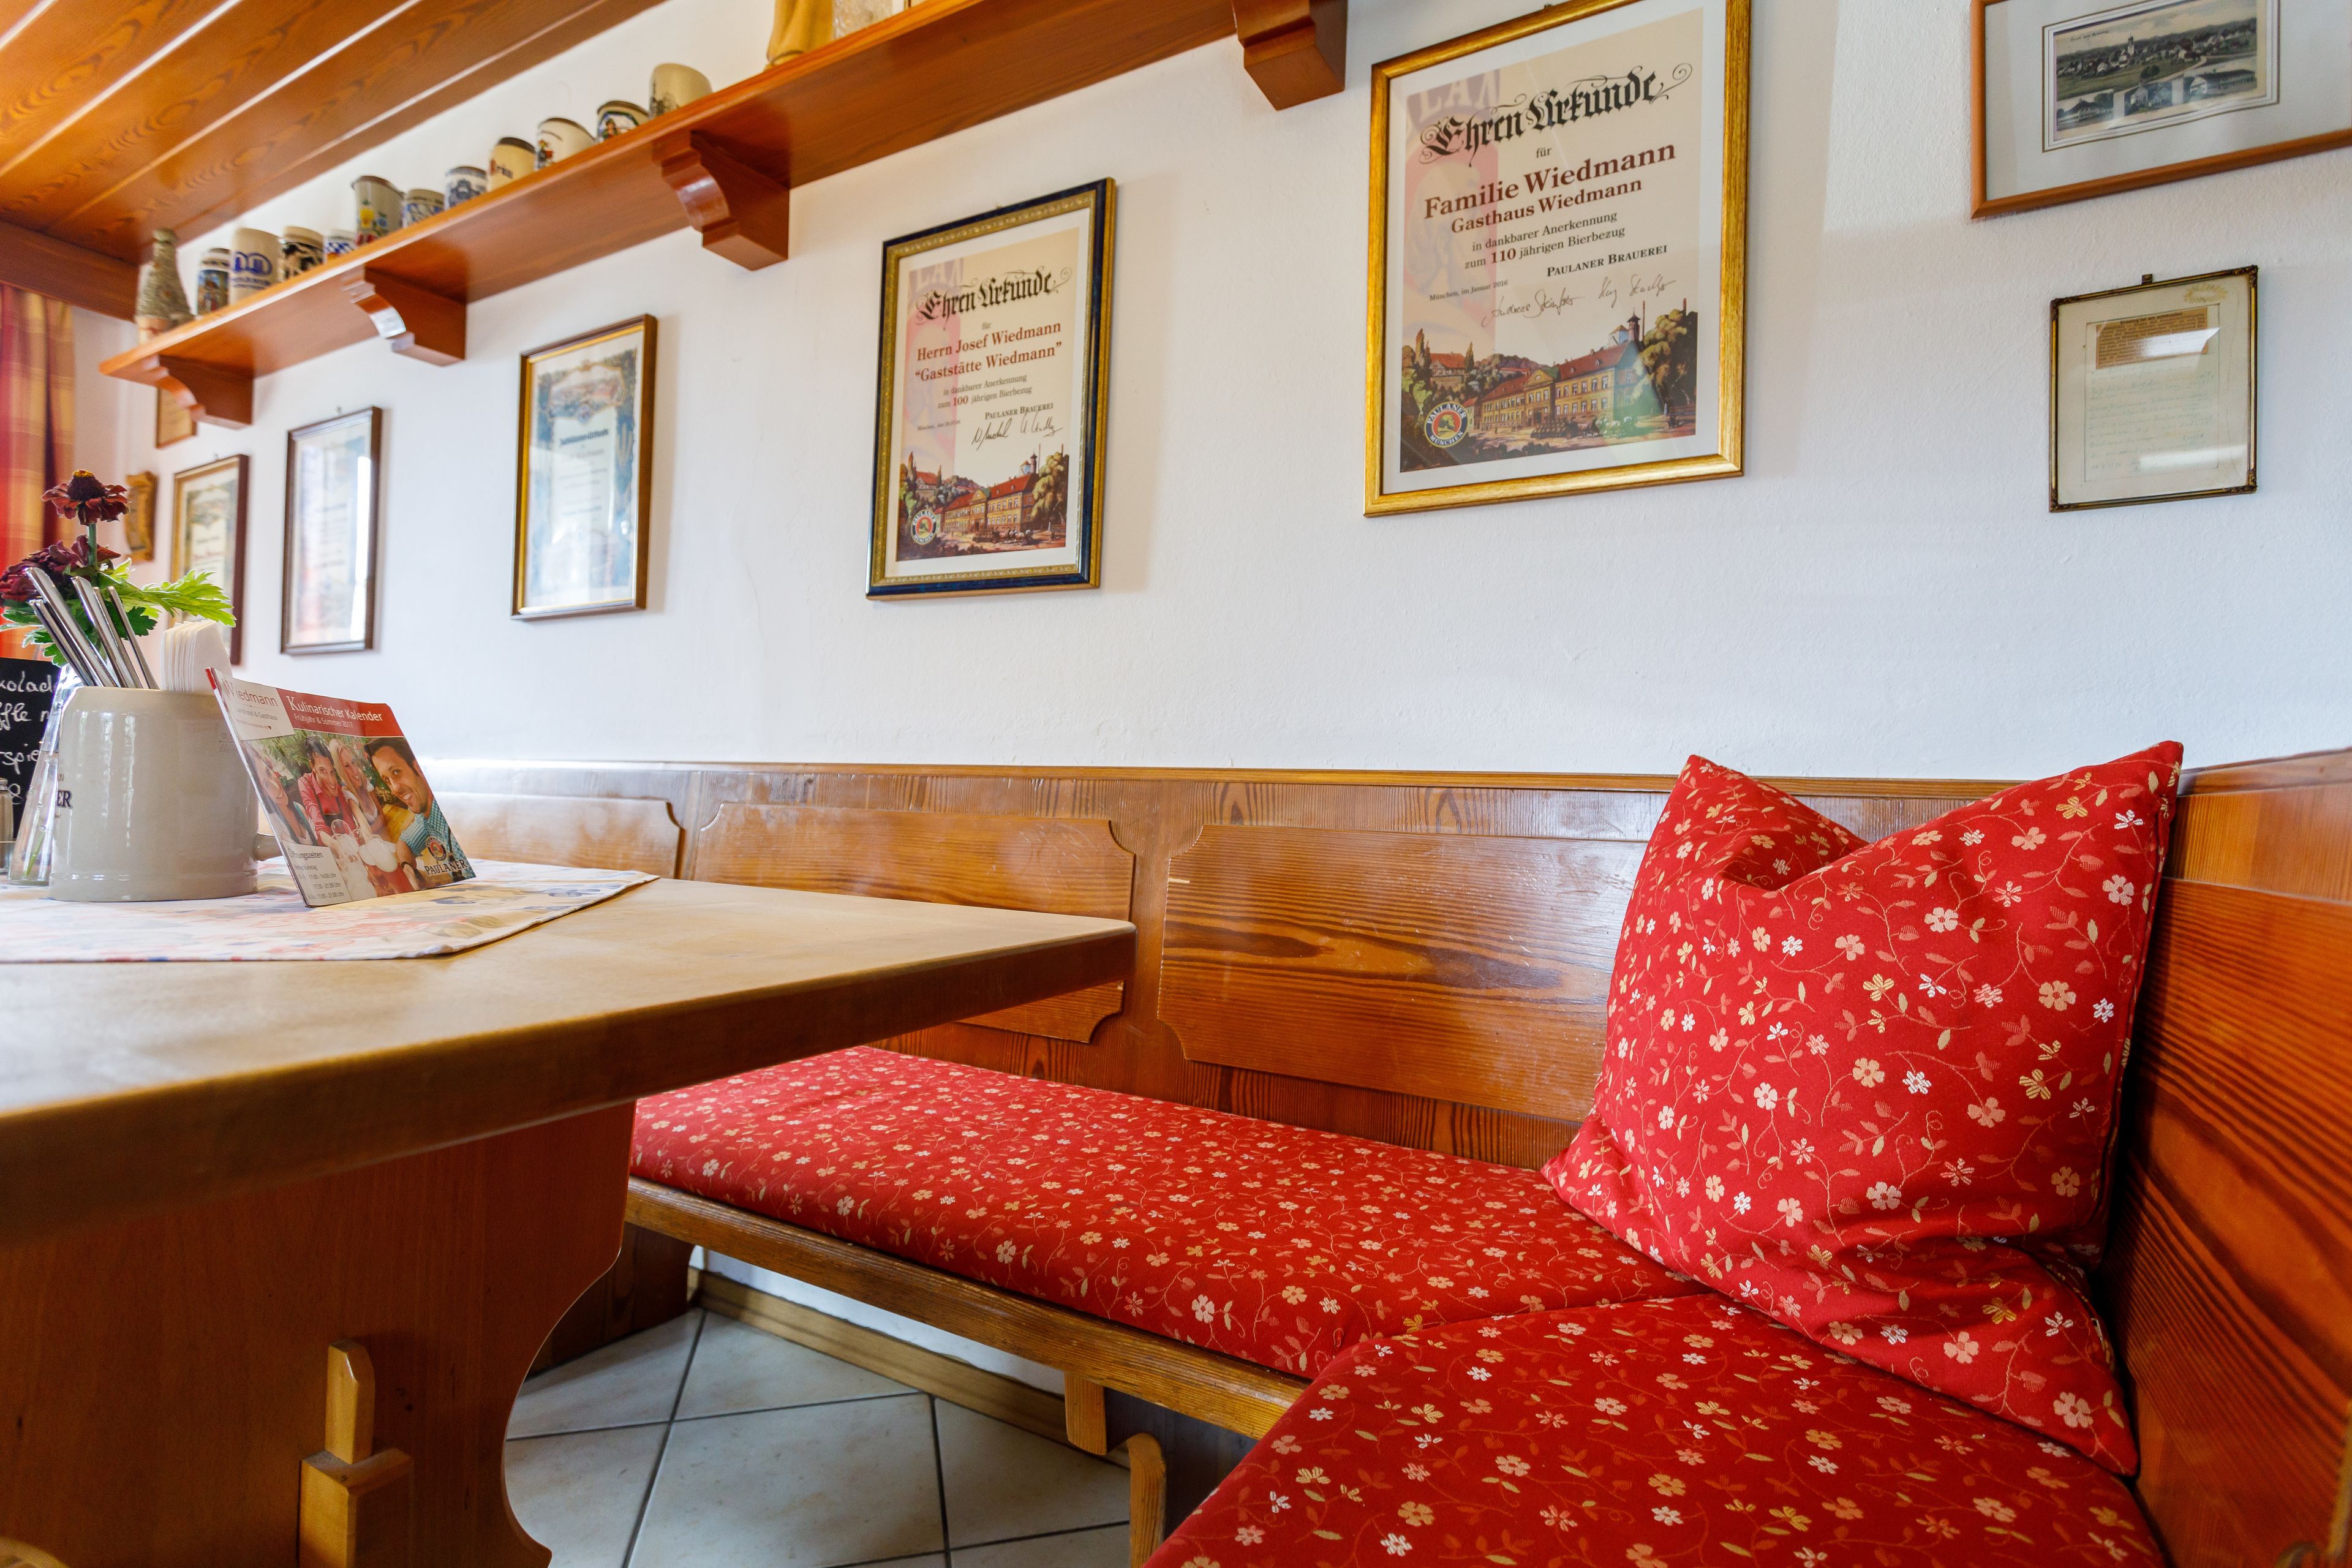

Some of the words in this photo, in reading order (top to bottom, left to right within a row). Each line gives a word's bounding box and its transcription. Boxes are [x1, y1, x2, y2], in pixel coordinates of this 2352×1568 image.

[1536, 146, 1552, 159] für
[1424, 181, 1519, 219] Familie
[1524, 144, 1676, 194] Wiedmann
[1452, 205, 1535, 233] Gasthaus
[1538, 179, 1642, 213] Wiedmann
[1472, 241, 1482, 252] in
[1485, 229, 1539, 248] dankbarer
[1542, 211, 1618, 236] Anerkennung
[1464, 257, 1487, 269] zum
[1491, 248, 1517, 263] 110
[1518, 239, 1564, 259] jährigen
[1567, 225, 1626, 246] Bierbezug
[1547, 258, 1604, 277] PAULANER
[1608, 244, 1667, 265] BRAUEREI
[1470, 284, 1491, 293] Januar
[1493, 279, 1508, 288] 2016
[917, 345, 952, 361] Herrn
[956, 334, 989, 353] Josef
[991, 322, 1061, 345] Wiedmann
[951, 382, 982, 394] dankbarer
[984, 375, 1027, 388] Anerkennung
[953, 395, 968, 406] 100
[971, 392, 997, 404] jährigen
[999, 386, 1032, 398] Bierbezug
[985, 409, 1017, 420] PAULANER
[1020, 402, 1054, 413] BRAUEREI
[221, 678, 279, 707] Wiedmann
[286, 696, 344, 717] Kulinarischer
[345, 709, 383, 722] Kalender
[294, 714, 316, 724] Frühjahr
[322, 717, 341, 726] Sommer
[424, 859, 467, 875] PAULANER
